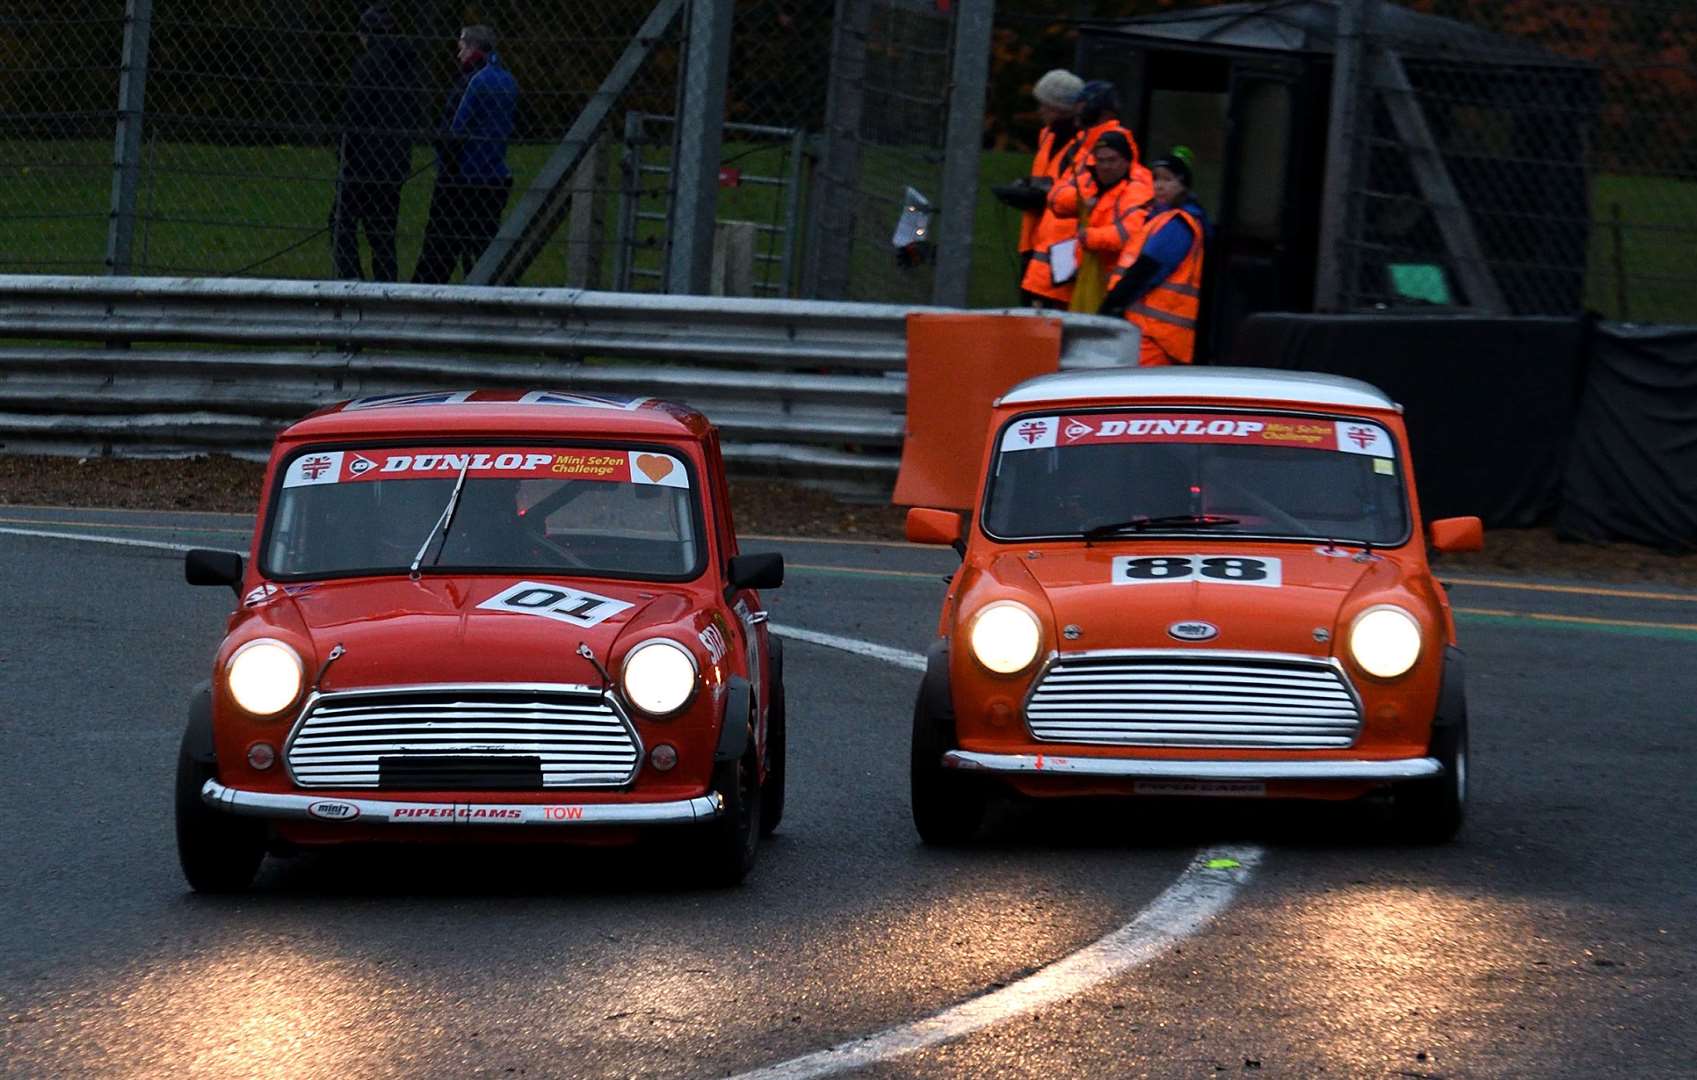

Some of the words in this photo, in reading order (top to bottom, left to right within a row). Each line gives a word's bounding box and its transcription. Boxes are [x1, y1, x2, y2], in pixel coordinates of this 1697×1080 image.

[1096, 420, 1264, 437] DUNLOP
[380, 453, 552, 473] DUNLOP
[556, 455, 586, 465] Mini
[587, 456, 625, 466] Se7en
[551, 464, 615, 476] Challenge
[1126, 557, 1267, 580] 88
[504, 588, 606, 620] 01
[393, 808, 455, 817] PIPER
[458, 808, 522, 818] CAMS
[543, 806, 583, 819] TOW
